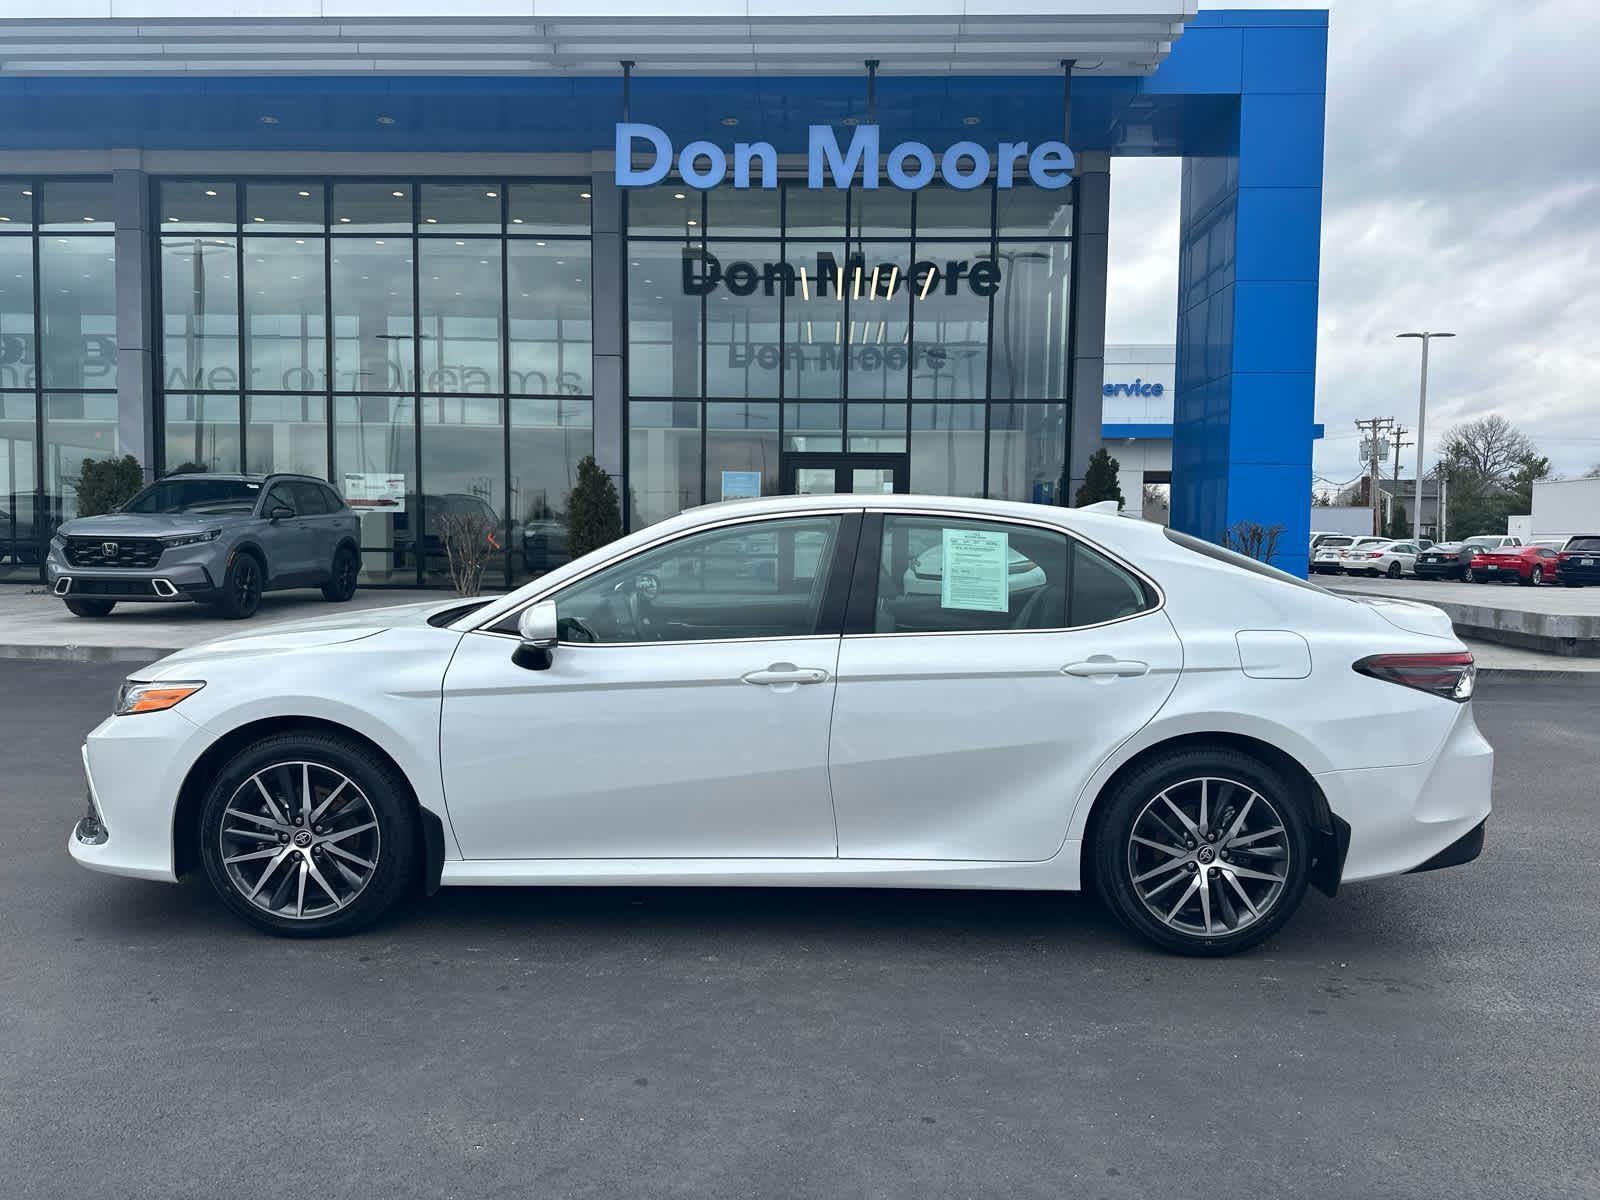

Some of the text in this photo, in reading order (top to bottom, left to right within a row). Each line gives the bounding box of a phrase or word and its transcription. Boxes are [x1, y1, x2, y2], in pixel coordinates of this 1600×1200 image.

[615, 122, 1076, 191] Don Moore
[681, 247, 1002, 297] Don Moore
